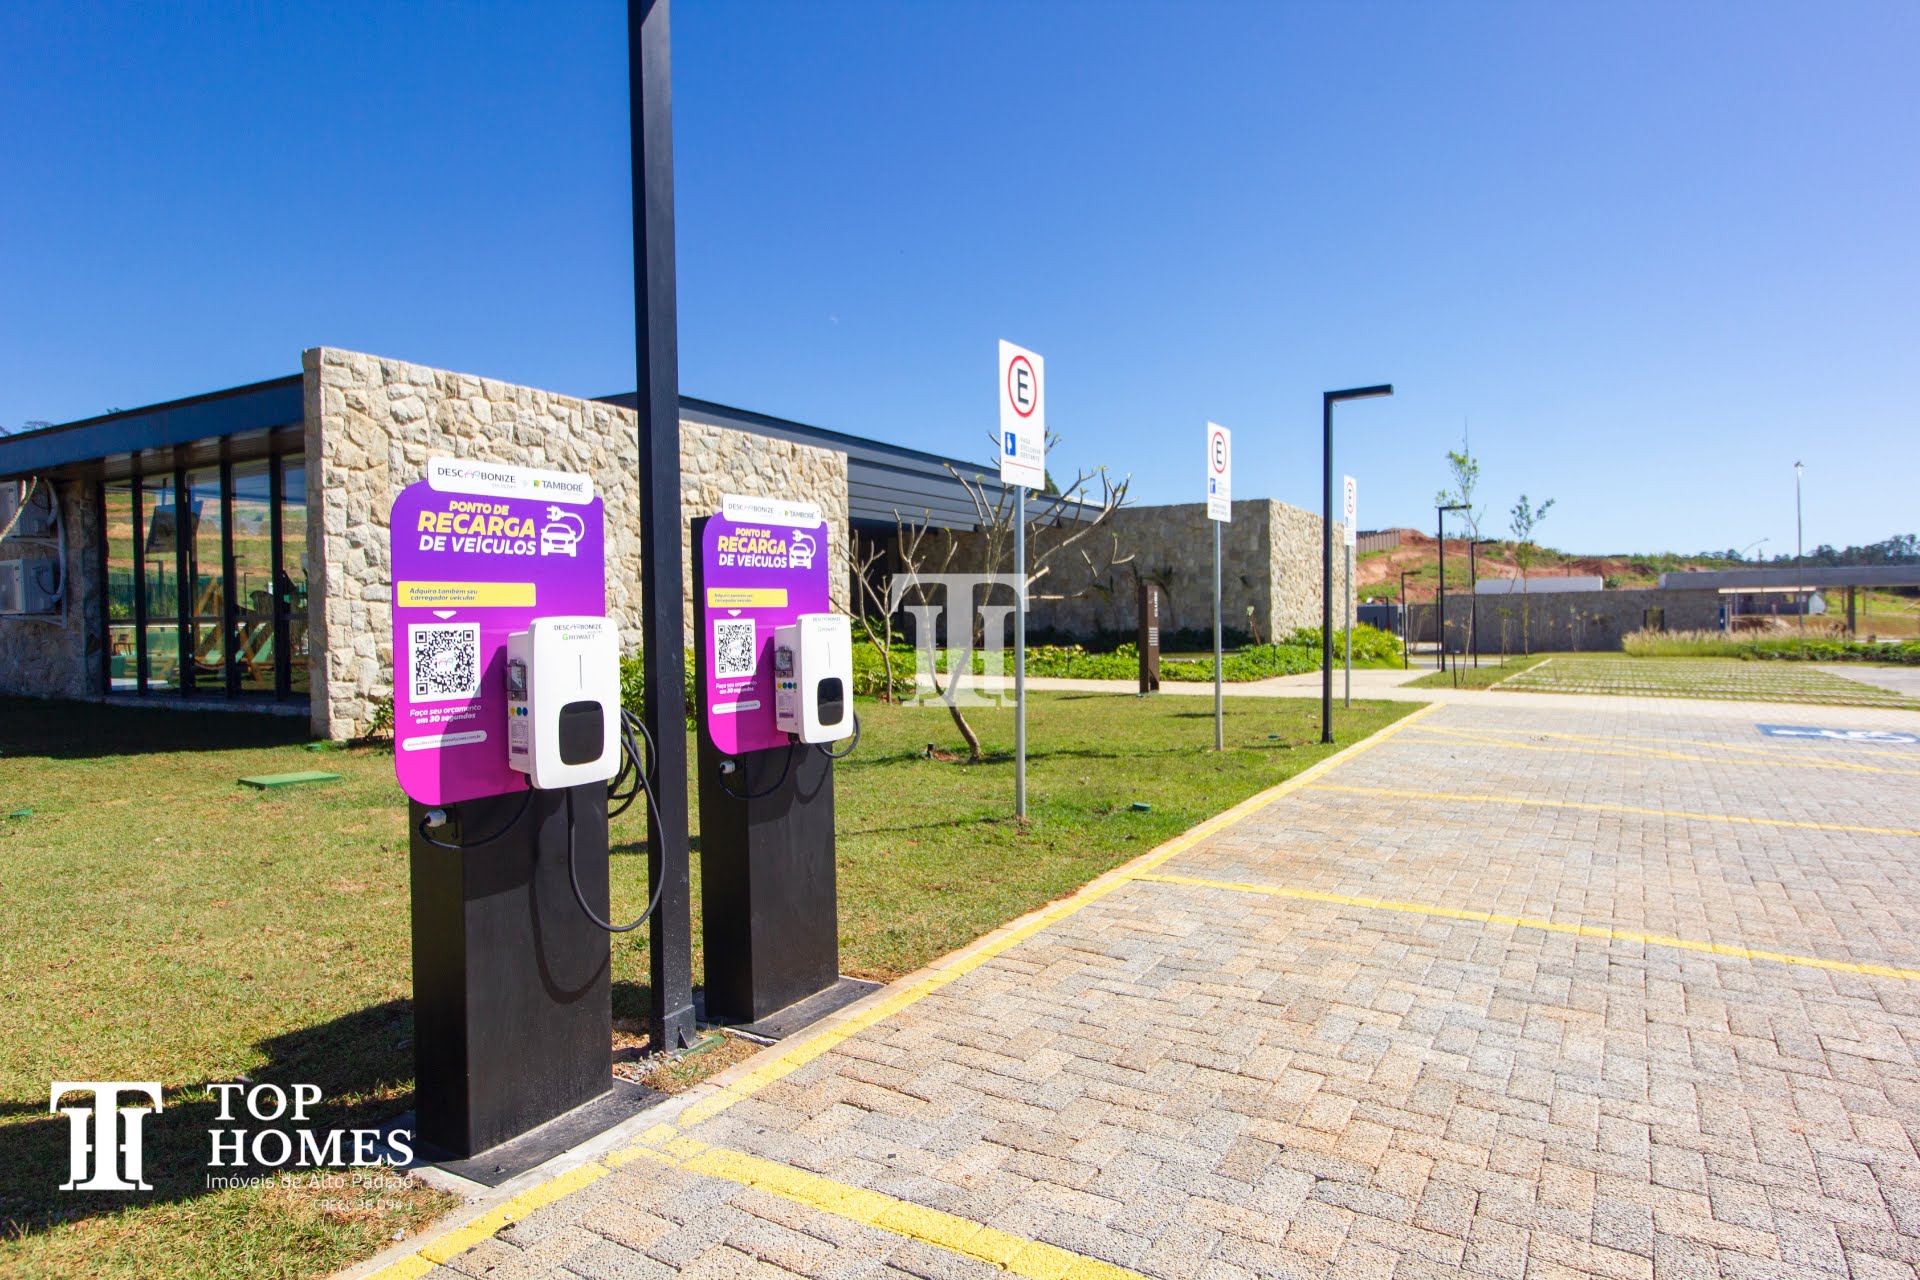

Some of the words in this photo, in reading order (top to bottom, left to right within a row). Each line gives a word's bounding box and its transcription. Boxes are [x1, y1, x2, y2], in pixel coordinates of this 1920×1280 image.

[1017, 367, 1029, 405] E
[1216, 440, 1223, 465] E
[542, 480, 584, 493] TAMBORÉ
[449, 500, 492, 514] PONTO
[493, 503, 510, 516] DE
[417, 510, 536, 539] RECARGA
[735, 527, 760, 538] PONTO
[760, 529, 771, 539] DE
[419, 535, 446, 552] DE
[452, 535, 537, 556] VEÍCULOS
[717, 535, 787, 555] RECARGA
[718, 553, 734, 567] DE
[737, 553, 788, 569] VEÍCULOS
[410, 594, 448, 602] carregador
[409, 709, 428, 718] Faça
[428, 708, 442, 716] seu
[443, 704, 482, 714] orçamento
[415, 717, 429, 725] em
[429, 714, 441, 723] 30
[441, 712, 477, 722] segundos
